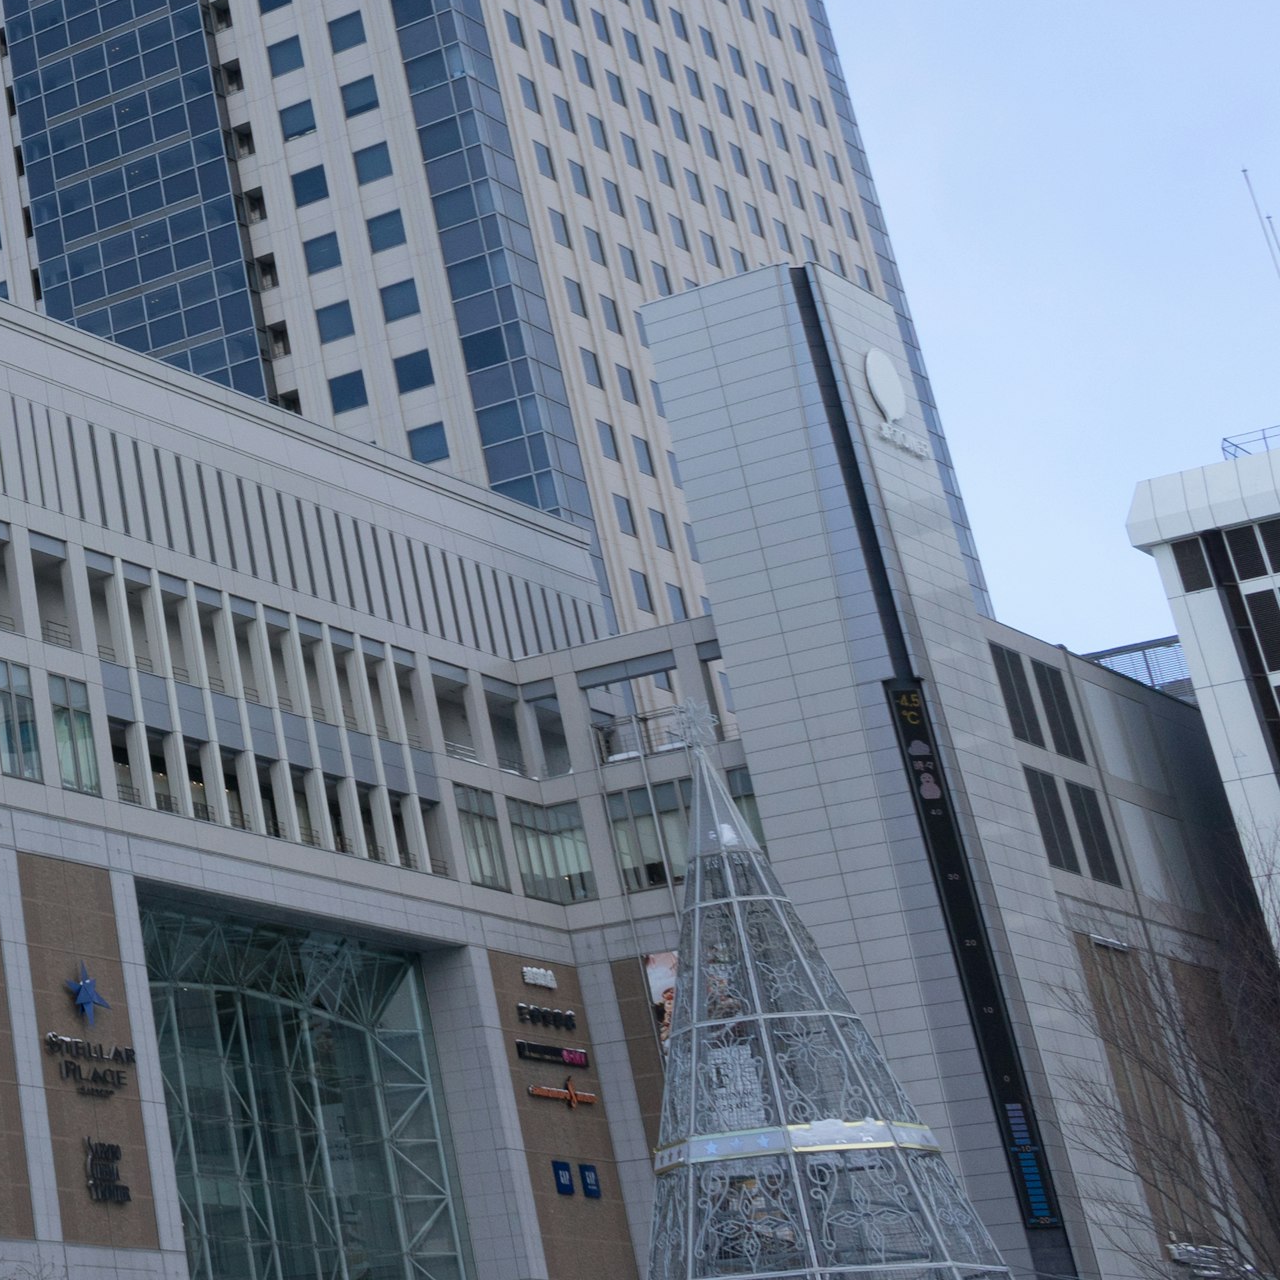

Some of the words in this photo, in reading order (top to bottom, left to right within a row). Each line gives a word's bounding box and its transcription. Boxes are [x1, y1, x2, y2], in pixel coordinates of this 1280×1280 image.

[947, 873, 960, 881] 30
[964, 939, 977, 947] 20
[983, 1006, 994, 1014] 10
[46, 1032, 136, 1065] STELLAR
[59, 1059, 128, 1088] PLACE
[1003, 1075, 1011, 1083] 0
[559, 1170, 570, 1185] GAP
